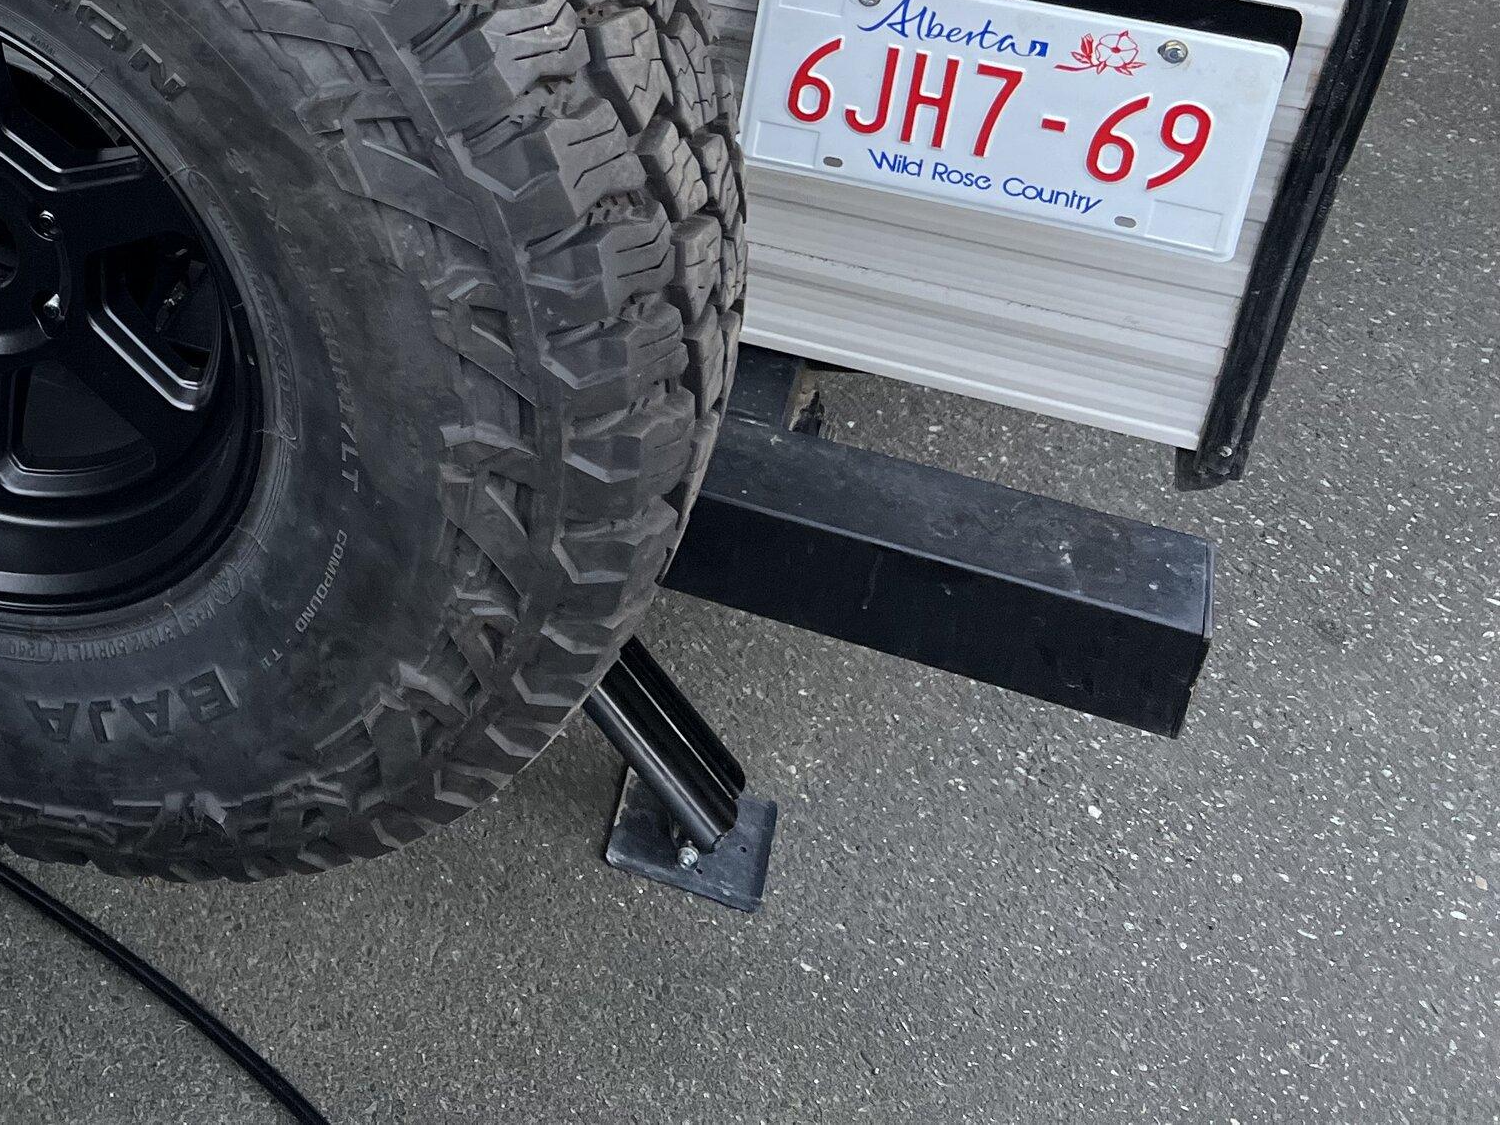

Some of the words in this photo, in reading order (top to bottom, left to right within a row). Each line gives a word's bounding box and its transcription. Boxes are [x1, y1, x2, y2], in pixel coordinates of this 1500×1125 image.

[867, 148, 924, 178] Wild
[931, 164, 992, 191] Rose
[1003, 177, 1103, 215] Country
[294, 529, 348, 634] COMPOUND
[24, 666, 240, 744] BAJA
